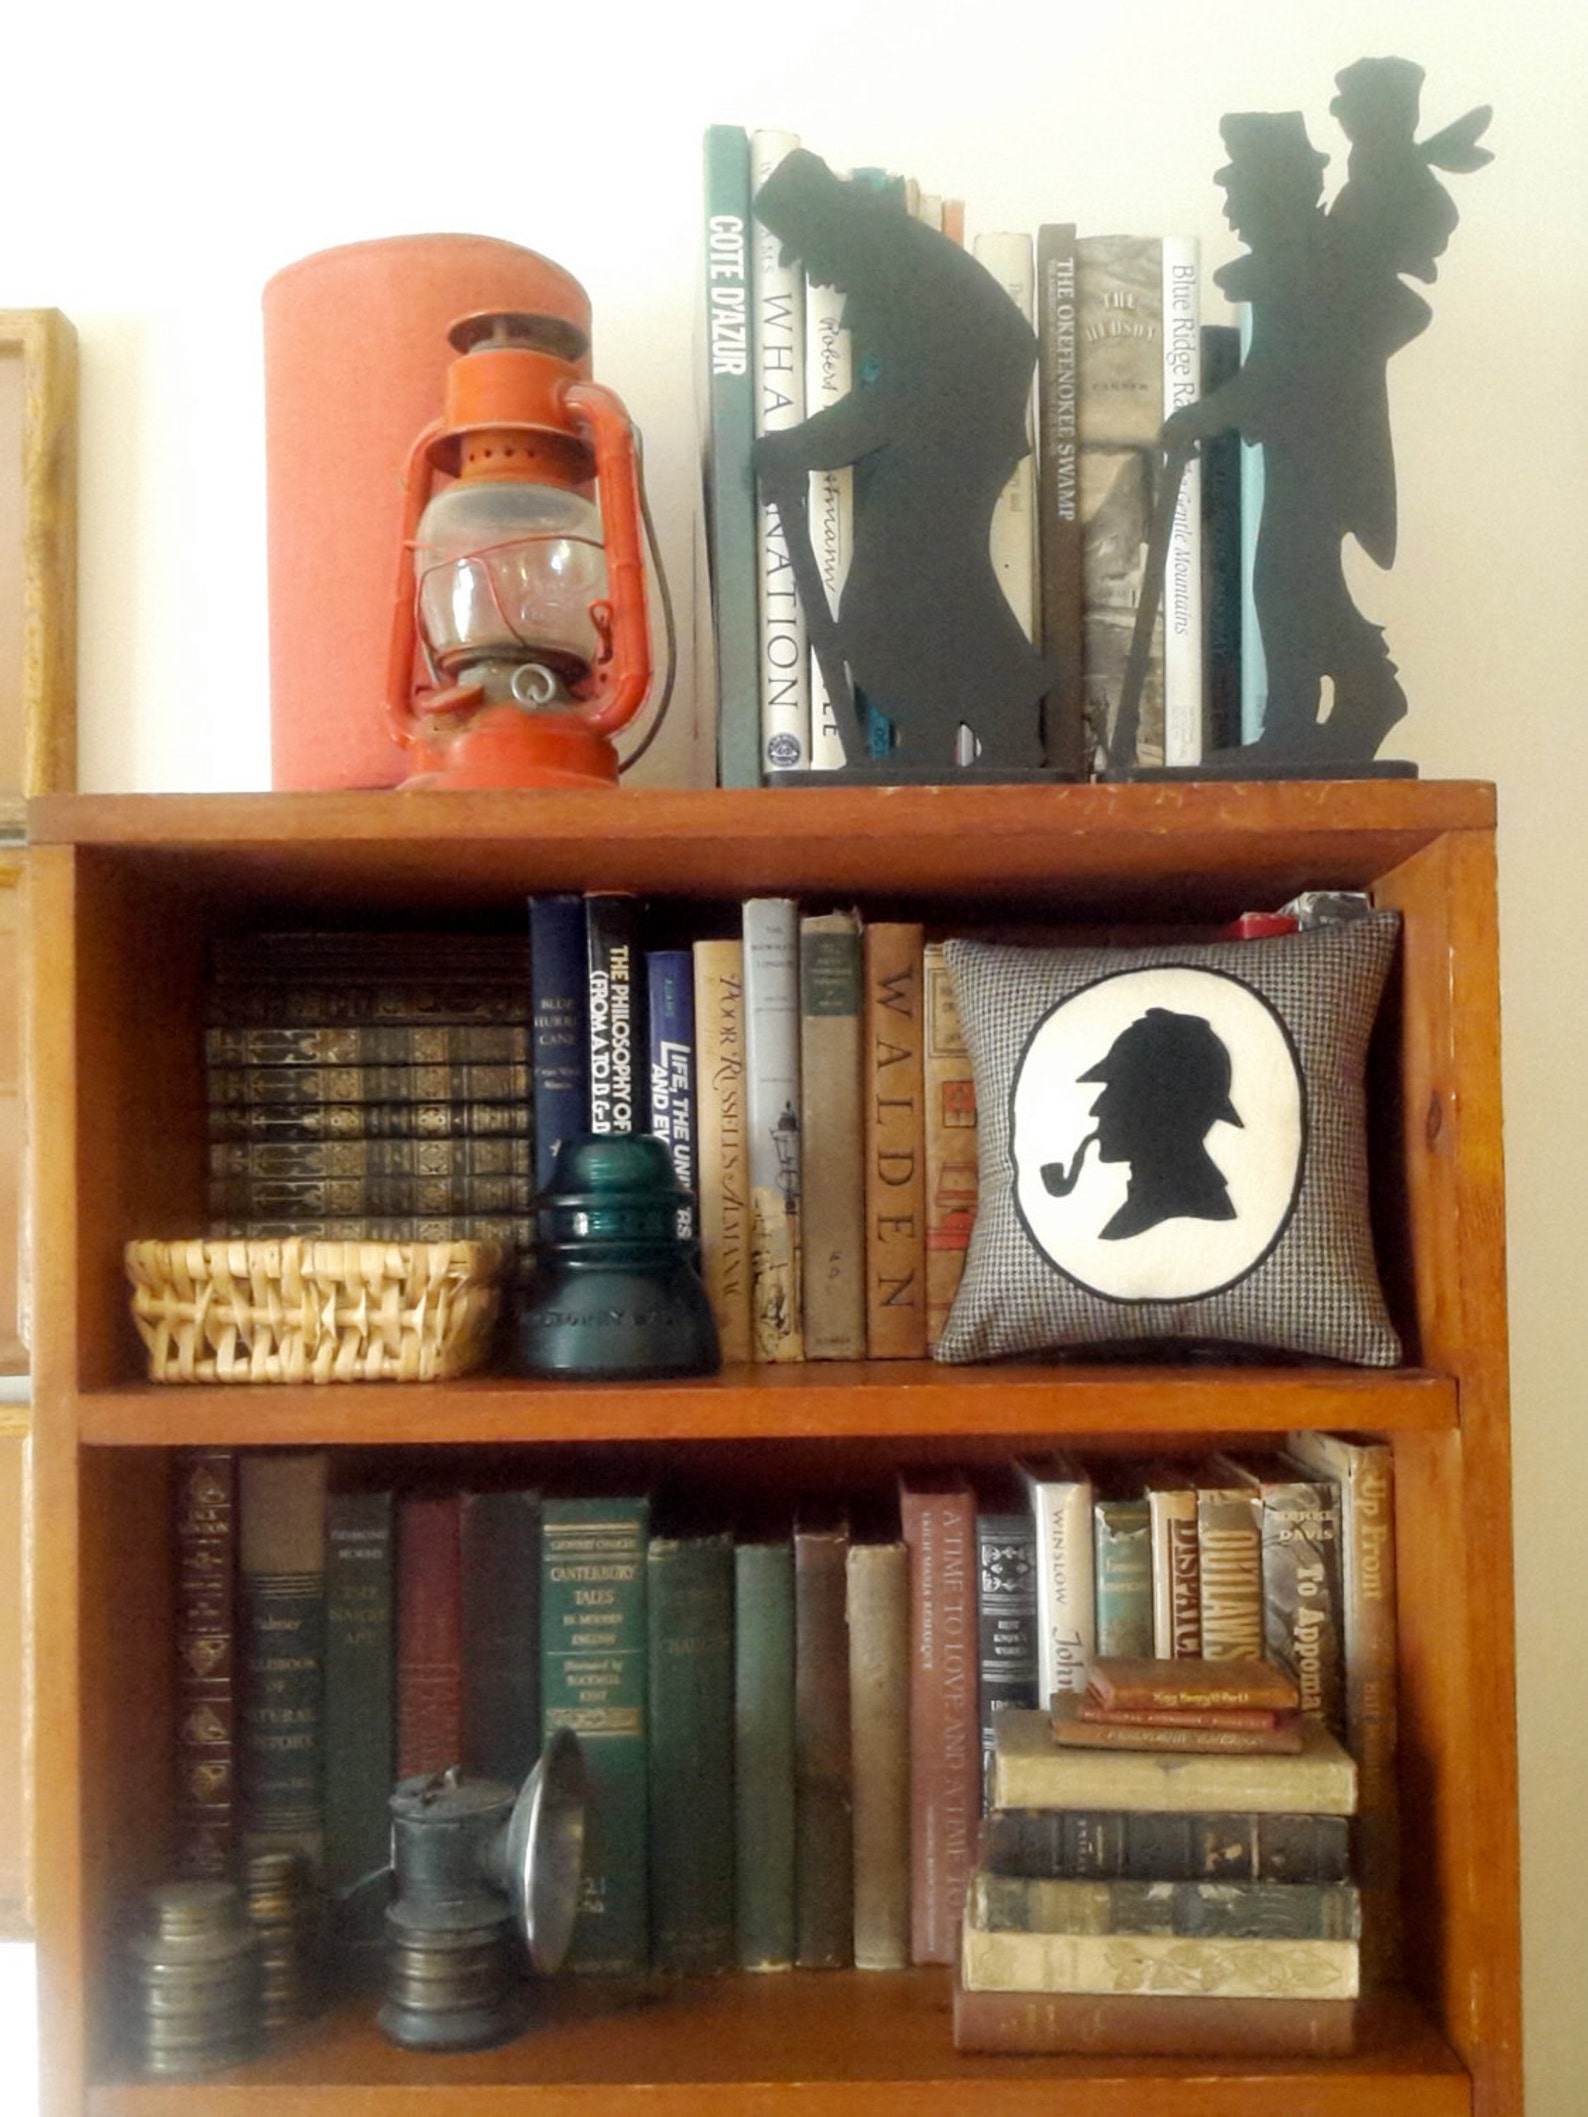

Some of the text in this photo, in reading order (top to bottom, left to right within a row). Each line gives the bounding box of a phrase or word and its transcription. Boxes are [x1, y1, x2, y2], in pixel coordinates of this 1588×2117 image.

[709, 215, 747, 376] COTE D'AZUR
[1171, 265, 1196, 310] Blue
[1165, 318, 1196, 377] Ridge
[1057, 257, 1076, 522] THE OKEFENOKEE SWAMP
[1174, 546, 1192, 636] Mountains
[719, 973, 742, 1045] POOR
[592, 1052, 610, 1079] TO
[610, 945, 633, 1133] THE PHILOSOPHY OF
[652, 1063, 669, 1110] AND
[672, 1098, 691, 1141] THE
[875, 964, 917, 1310] WALDEN
[943, 1511, 962, 1527] A
[1280, 1529, 1334, 1541] DAVIS
[1355, 1476, 1388, 1599] Up Front
[550, 1566, 635, 1582] CANTERBURY
[943, 1534, 964, 1592] TIME
[1052, 1507, 1067, 1605] WINSLOW
[1296, 1563, 1325, 1597] To
[574, 1590, 615, 1605] TALES
[944, 1600, 964, 1636] TO
[1200, 1530, 1262, 1660] OUTLAWS
[944, 1643, 965, 1706] LOVE
